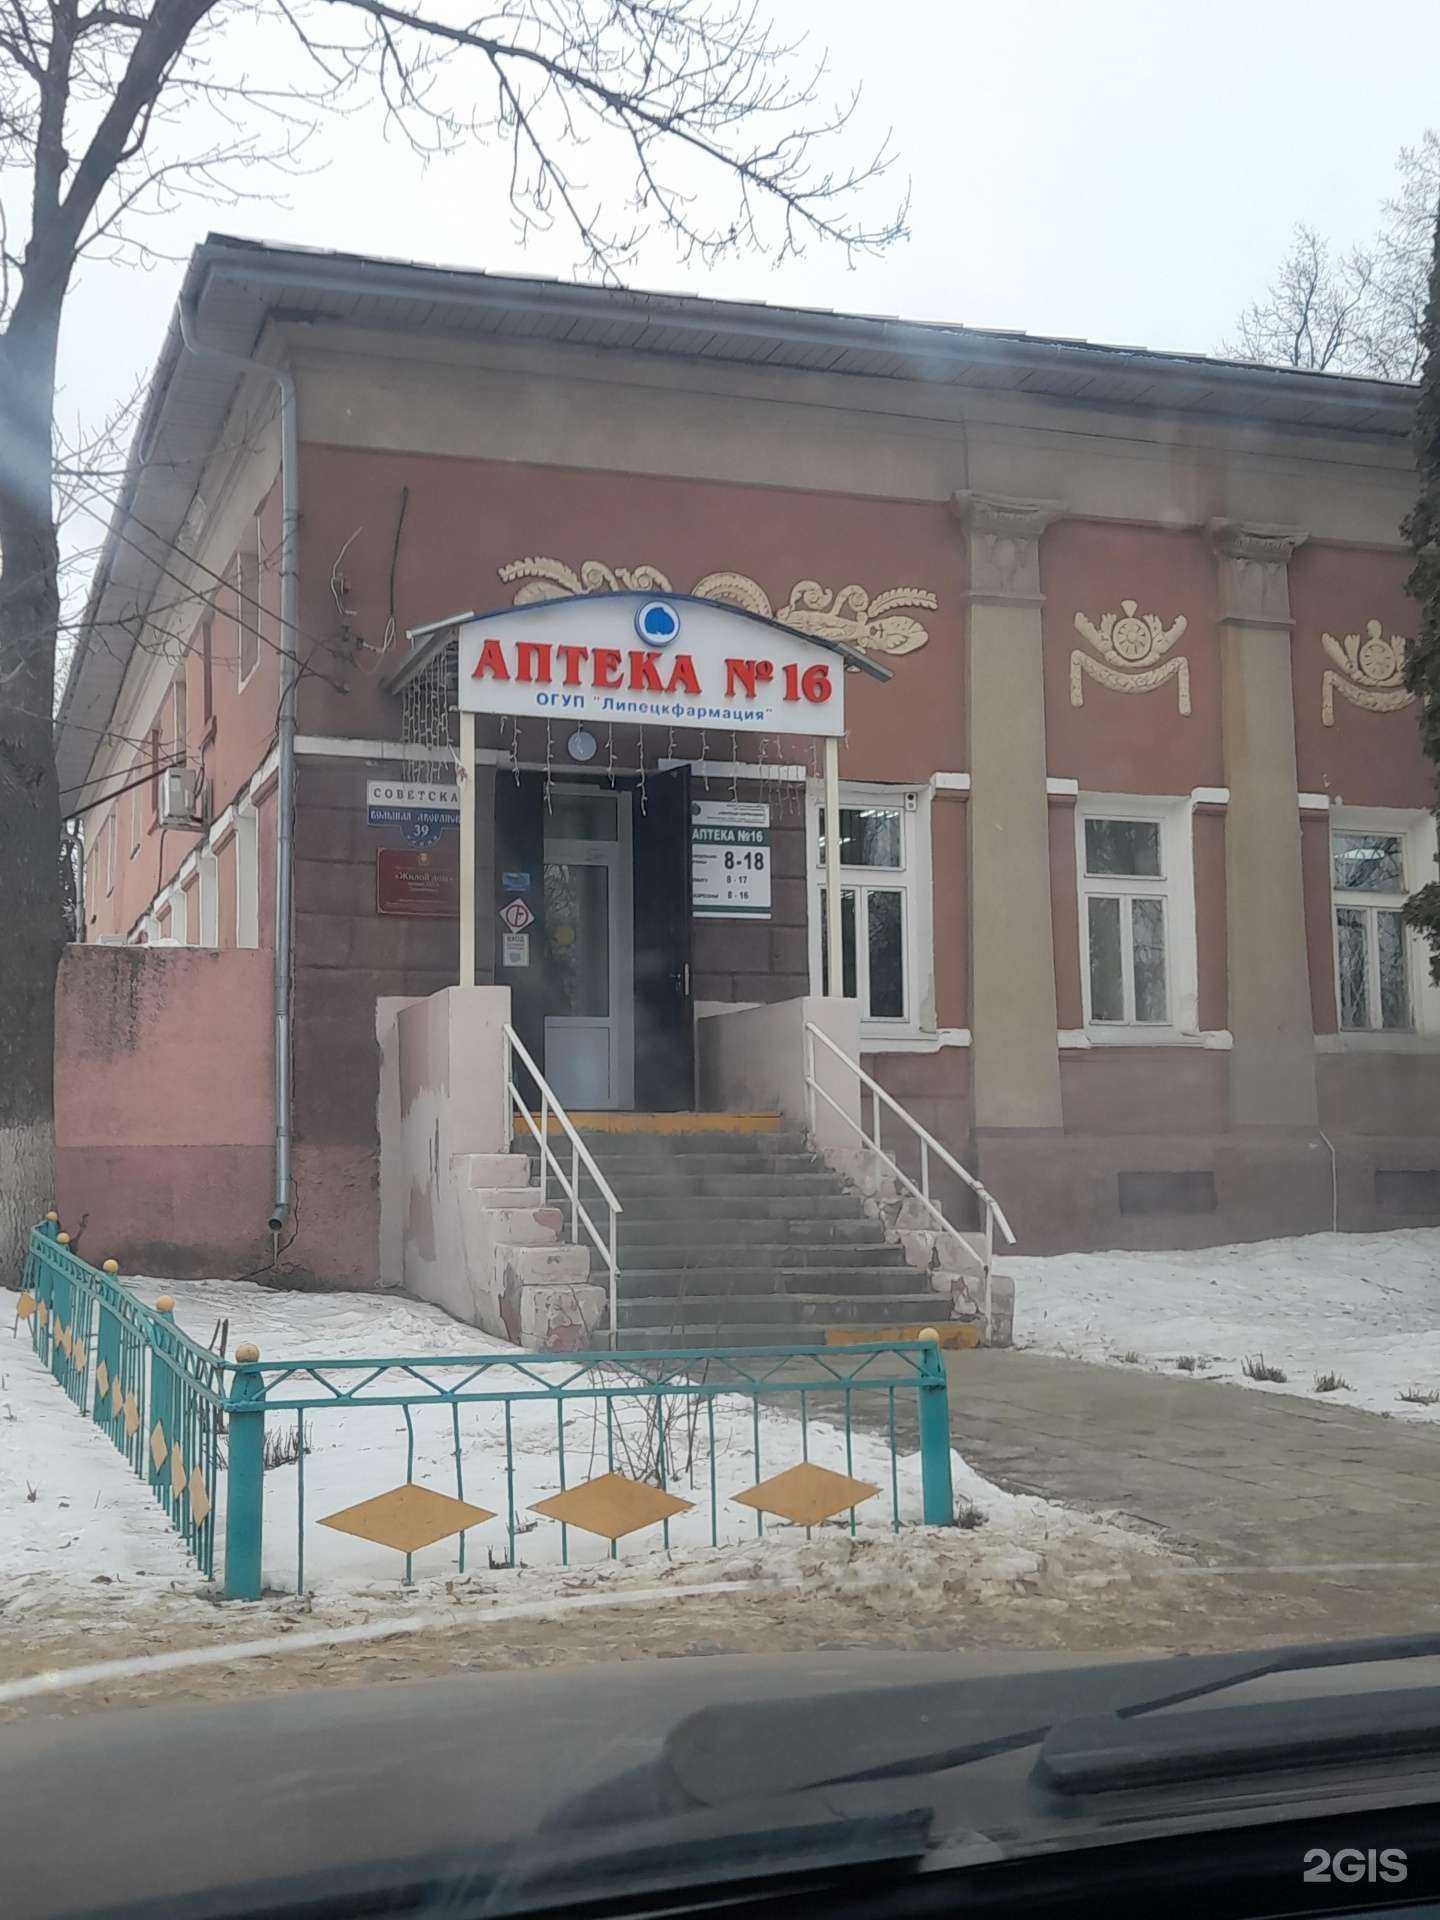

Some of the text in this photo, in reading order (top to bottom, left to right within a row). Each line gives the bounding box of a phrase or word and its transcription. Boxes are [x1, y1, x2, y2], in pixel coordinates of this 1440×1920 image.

[472, 640, 702, 695] АПТЕКА
[782, 664, 833, 703] 16
[536, 692, 774, 722] ОГУП "Липецкфармация"
[373, 787, 458, 802] СОВЕТСКА
[413, 824, 430, 837] 39
[692, 828, 764, 843] АПТЕКА №16
